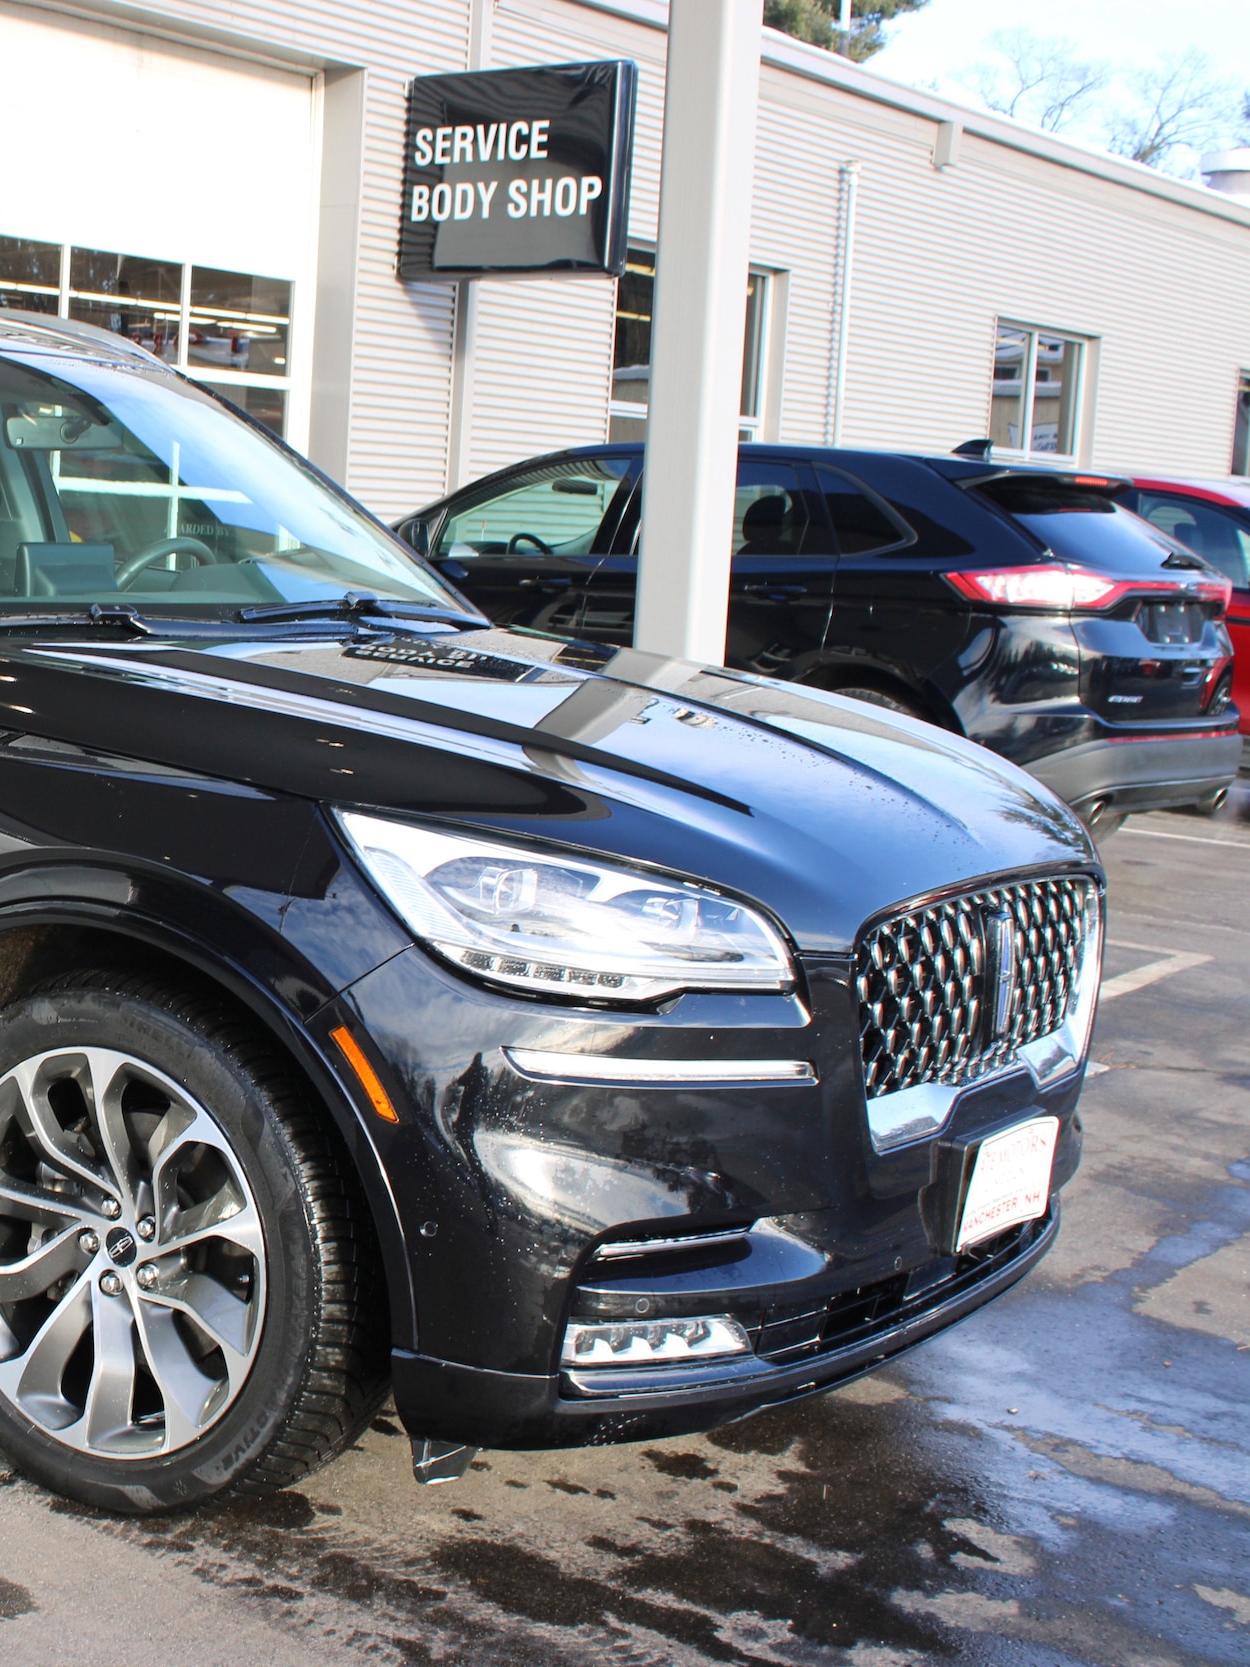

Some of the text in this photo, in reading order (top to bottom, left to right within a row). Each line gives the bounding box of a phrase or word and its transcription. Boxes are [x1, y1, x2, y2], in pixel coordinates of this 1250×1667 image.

[414, 120, 550, 167] SERVICE
[411, 176, 602, 222] BODY SHOP
[1025, 1191, 1041, 1204] NH
